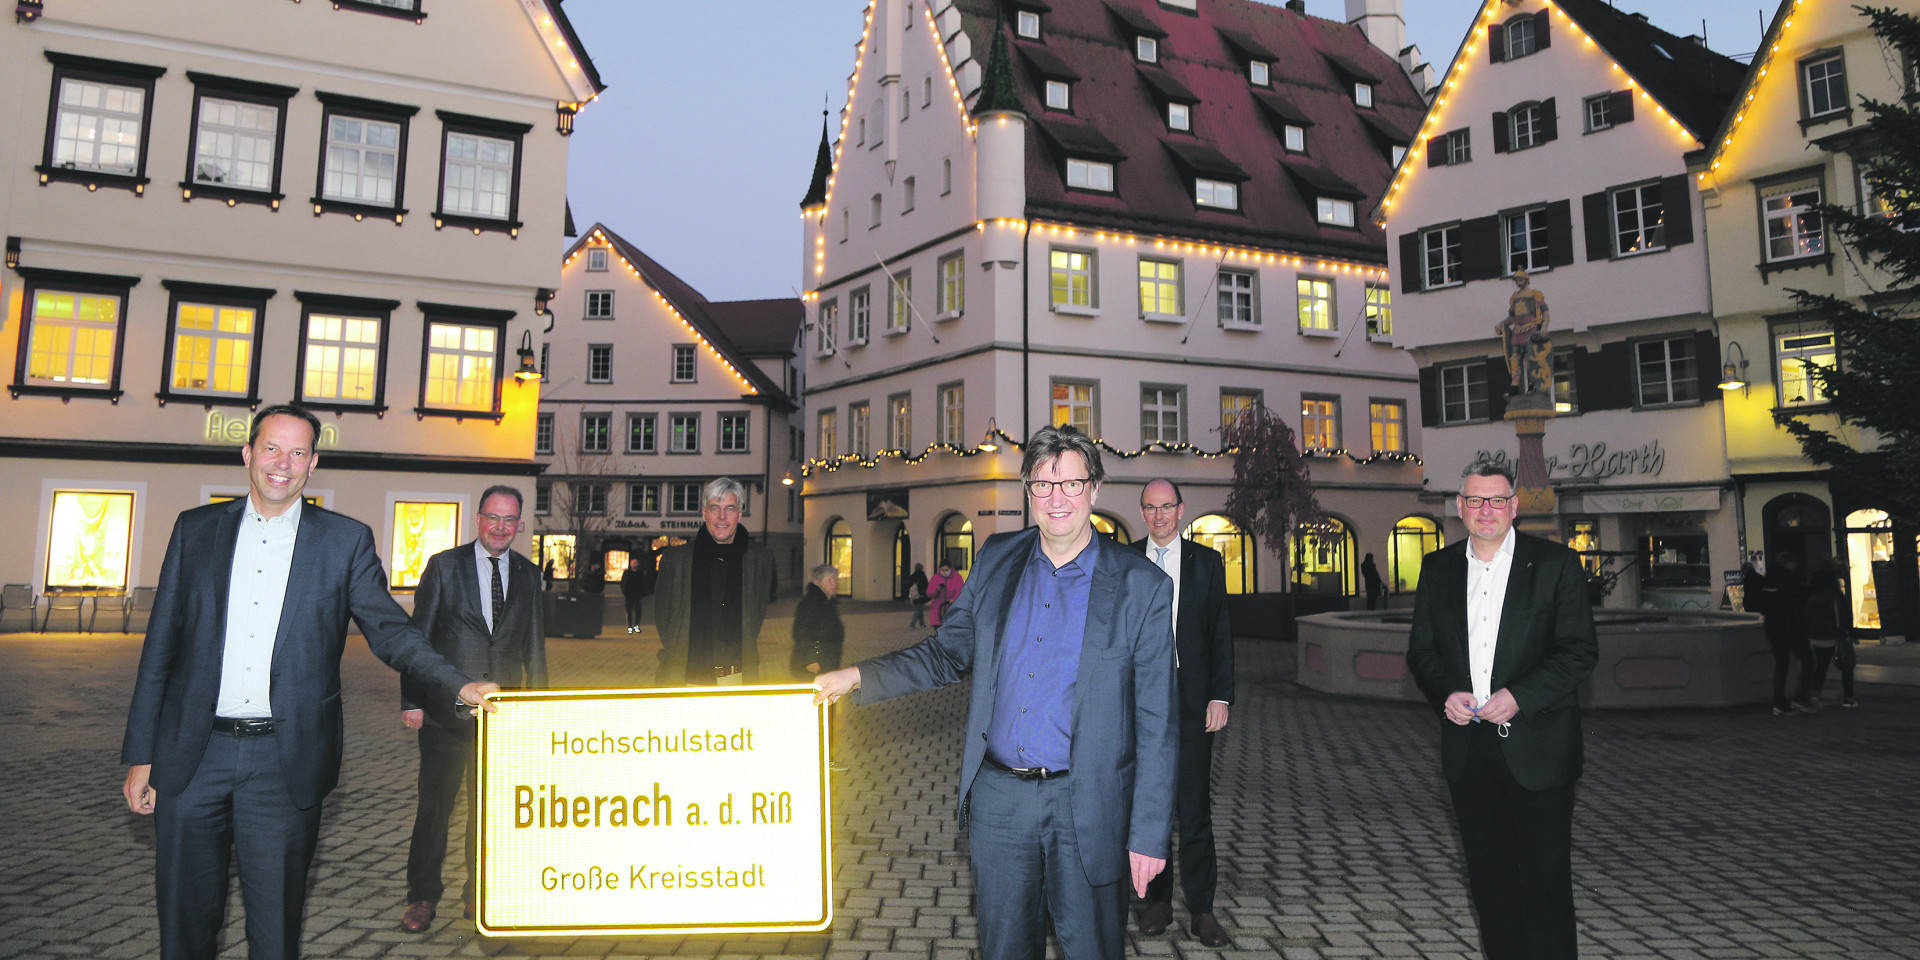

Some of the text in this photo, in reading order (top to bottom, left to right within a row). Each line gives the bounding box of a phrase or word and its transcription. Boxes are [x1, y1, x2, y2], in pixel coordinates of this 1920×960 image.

[614, 520, 650, 529] Tabak
[551, 727, 754, 755] Hochschulstadt
[514, 782, 792, 829] Biberach a. d. Riß
[541, 863, 765, 891] Große Kreisstadt
